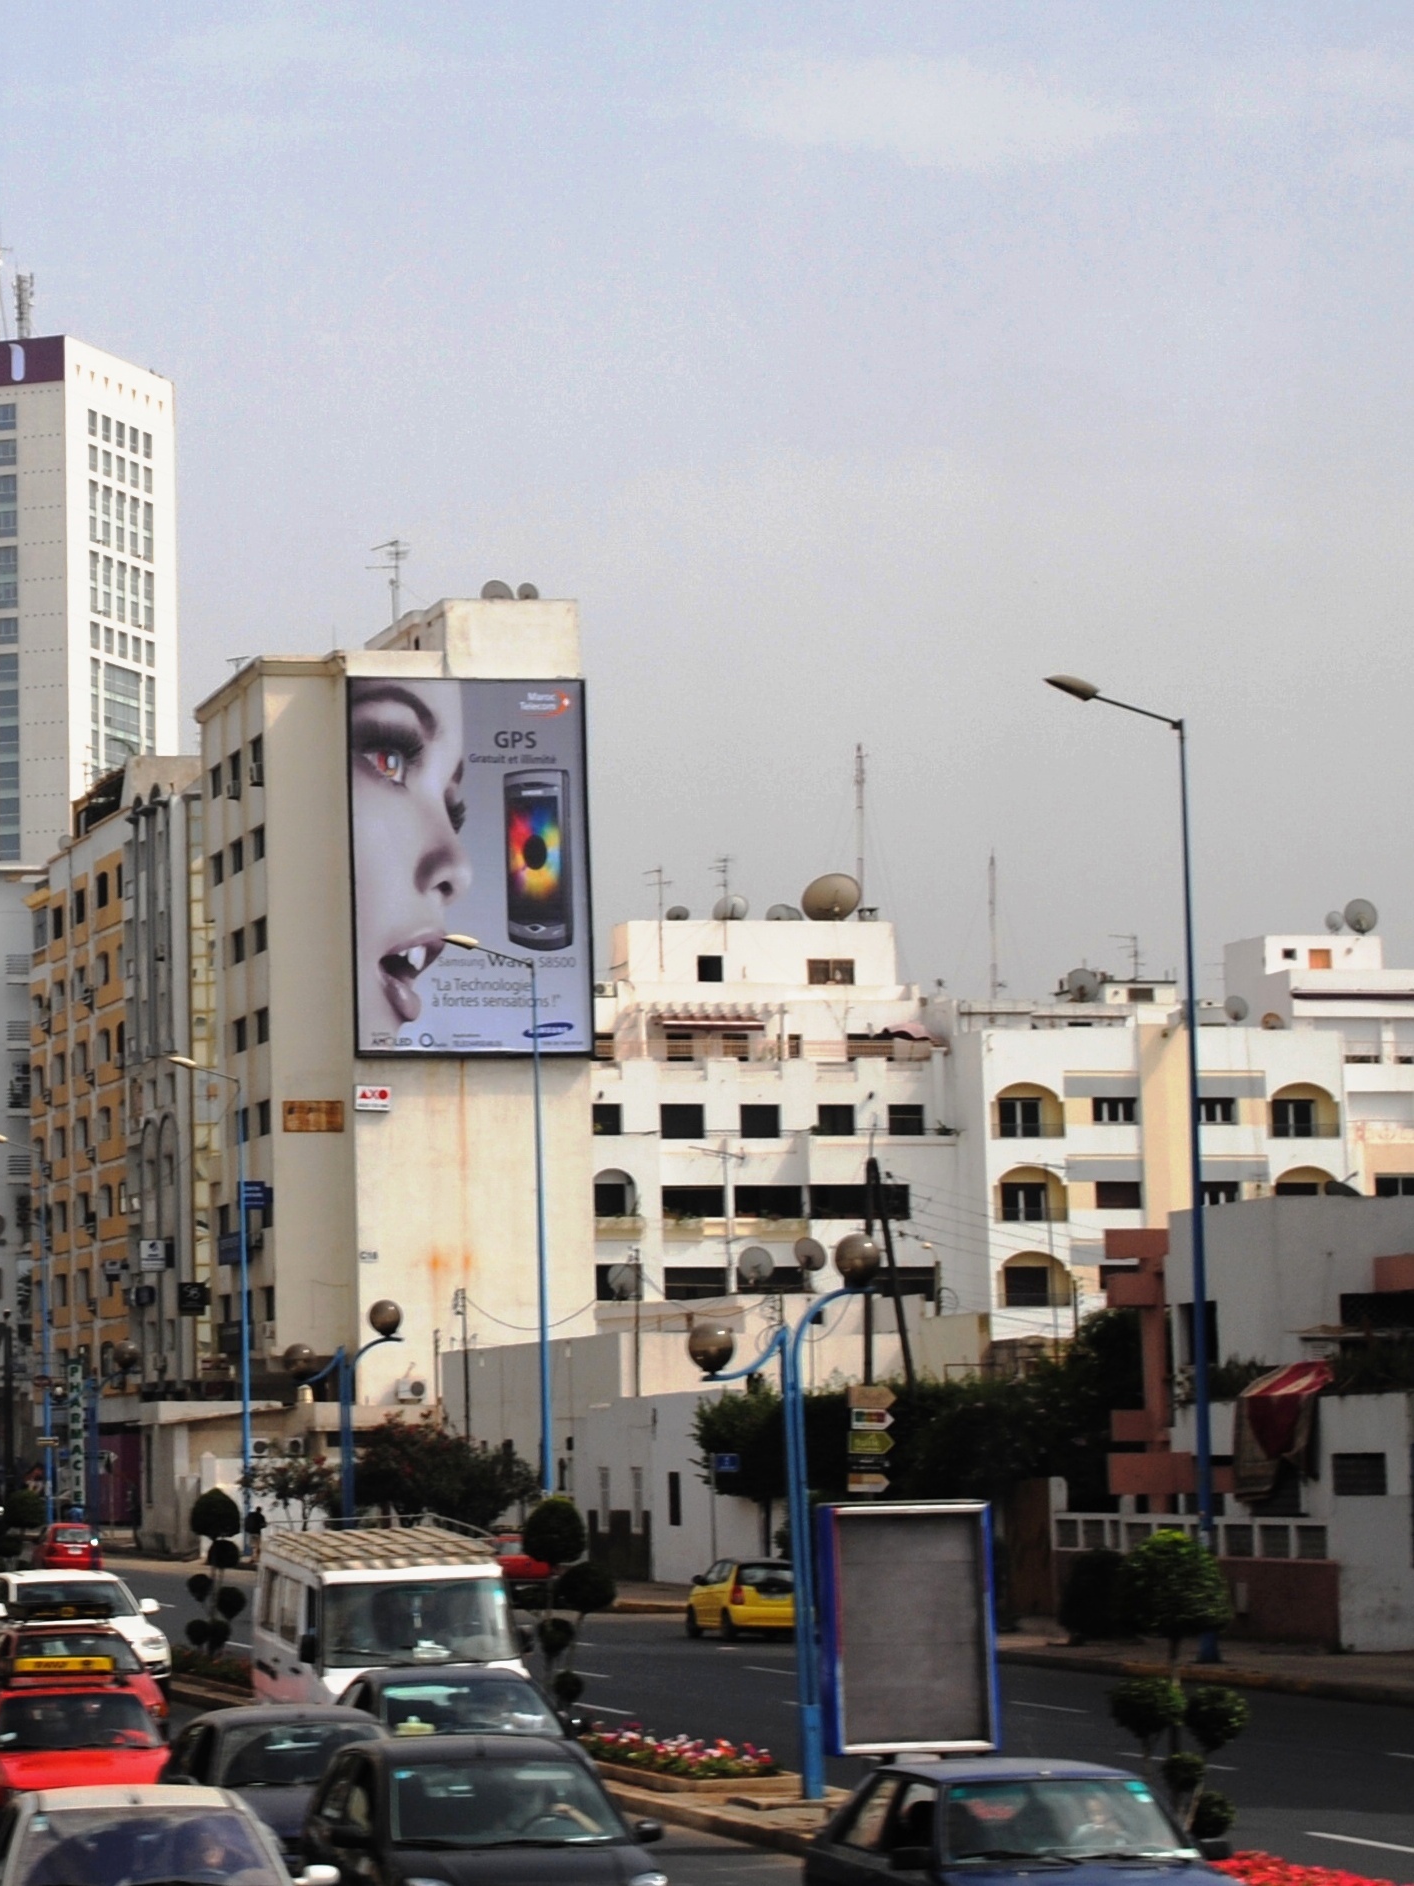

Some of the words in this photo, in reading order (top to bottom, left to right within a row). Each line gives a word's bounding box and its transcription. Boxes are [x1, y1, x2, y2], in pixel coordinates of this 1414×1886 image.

[494, 730, 537, 749] GPS
[469, 753, 505, 764] Gratuit
[508, 755, 518, 764] et
[438, 956, 486, 970] Samsung
[538, 956, 577, 968] S8500
[453, 977, 533, 995] Technologie
[432, 993, 440, 1007] à
[442, 993, 479, 1007] fortes
[482, 994, 549, 1008] sensations
[69, 1366, 84, 1502] PHARMACIE
